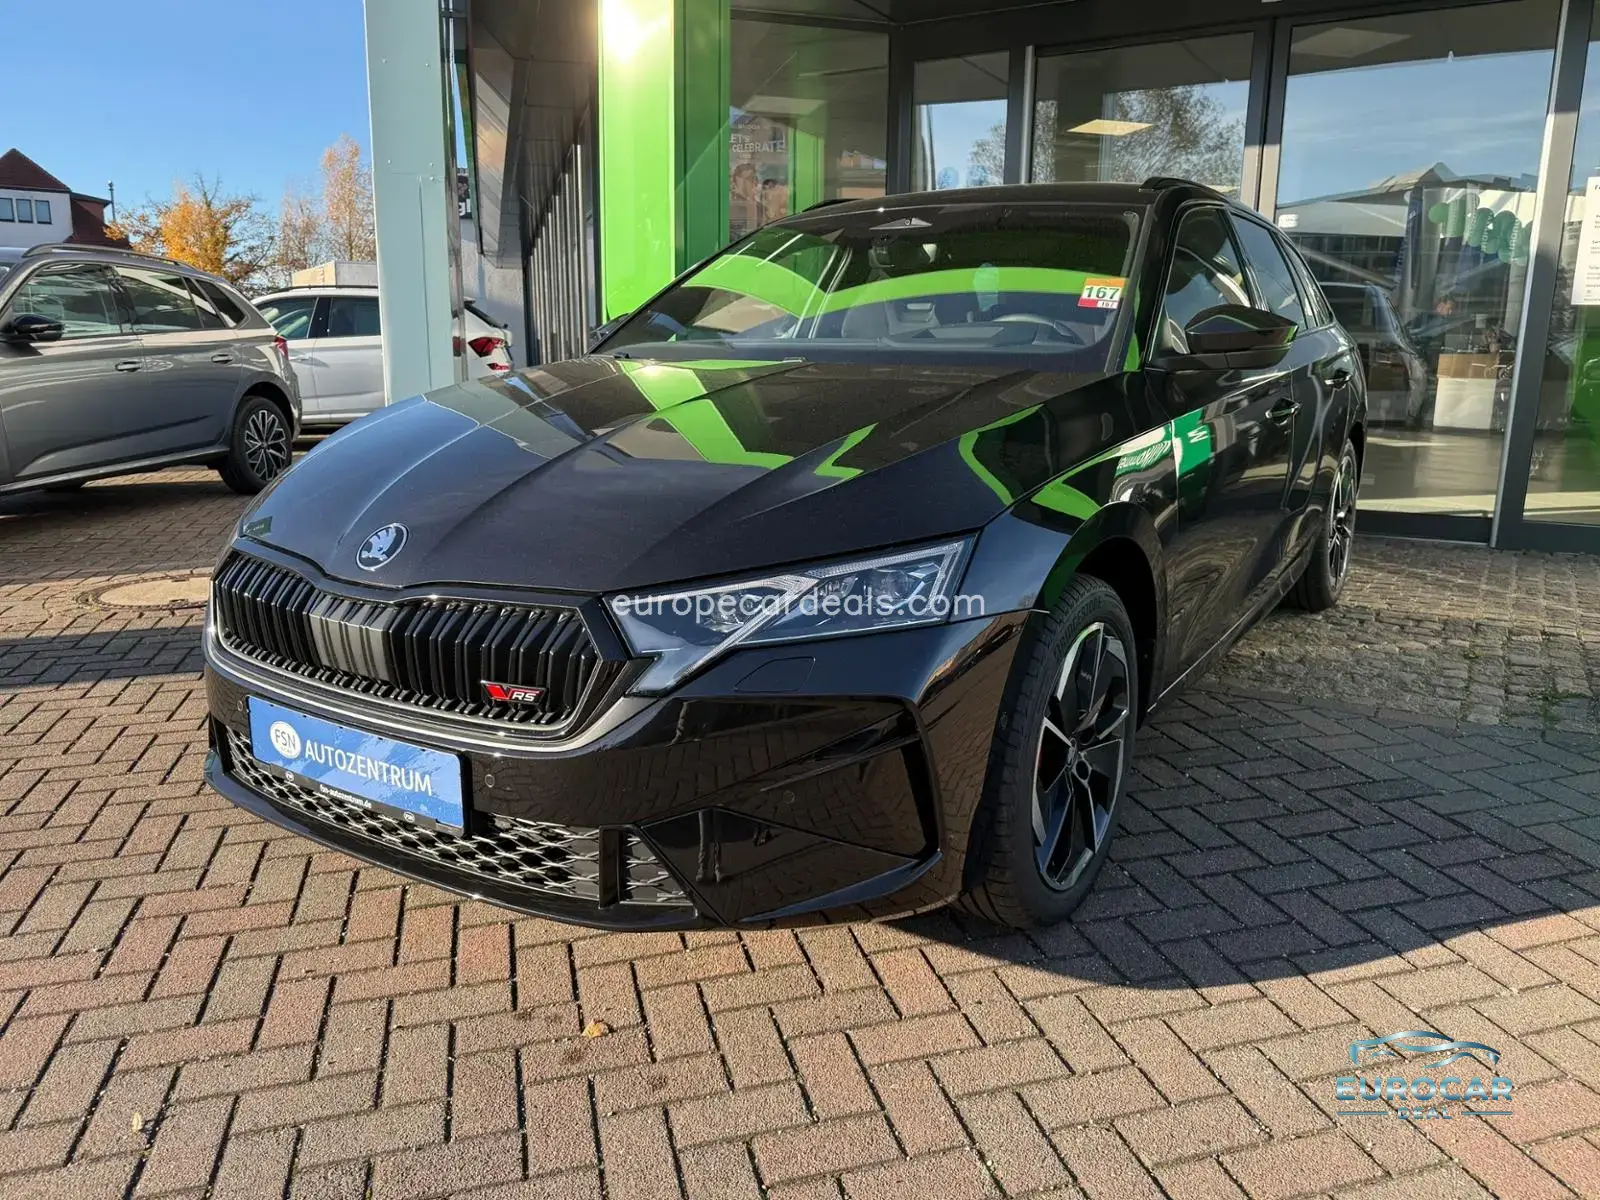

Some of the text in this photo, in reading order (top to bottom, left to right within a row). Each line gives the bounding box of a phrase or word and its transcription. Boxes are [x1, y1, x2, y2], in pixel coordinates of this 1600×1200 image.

[732, 139, 786, 153] CELEBRATE
[1084, 286, 1120, 300] 167
[274, 728, 297, 750] FSN
[304, 739, 433, 797] AUTOZENTRUM
